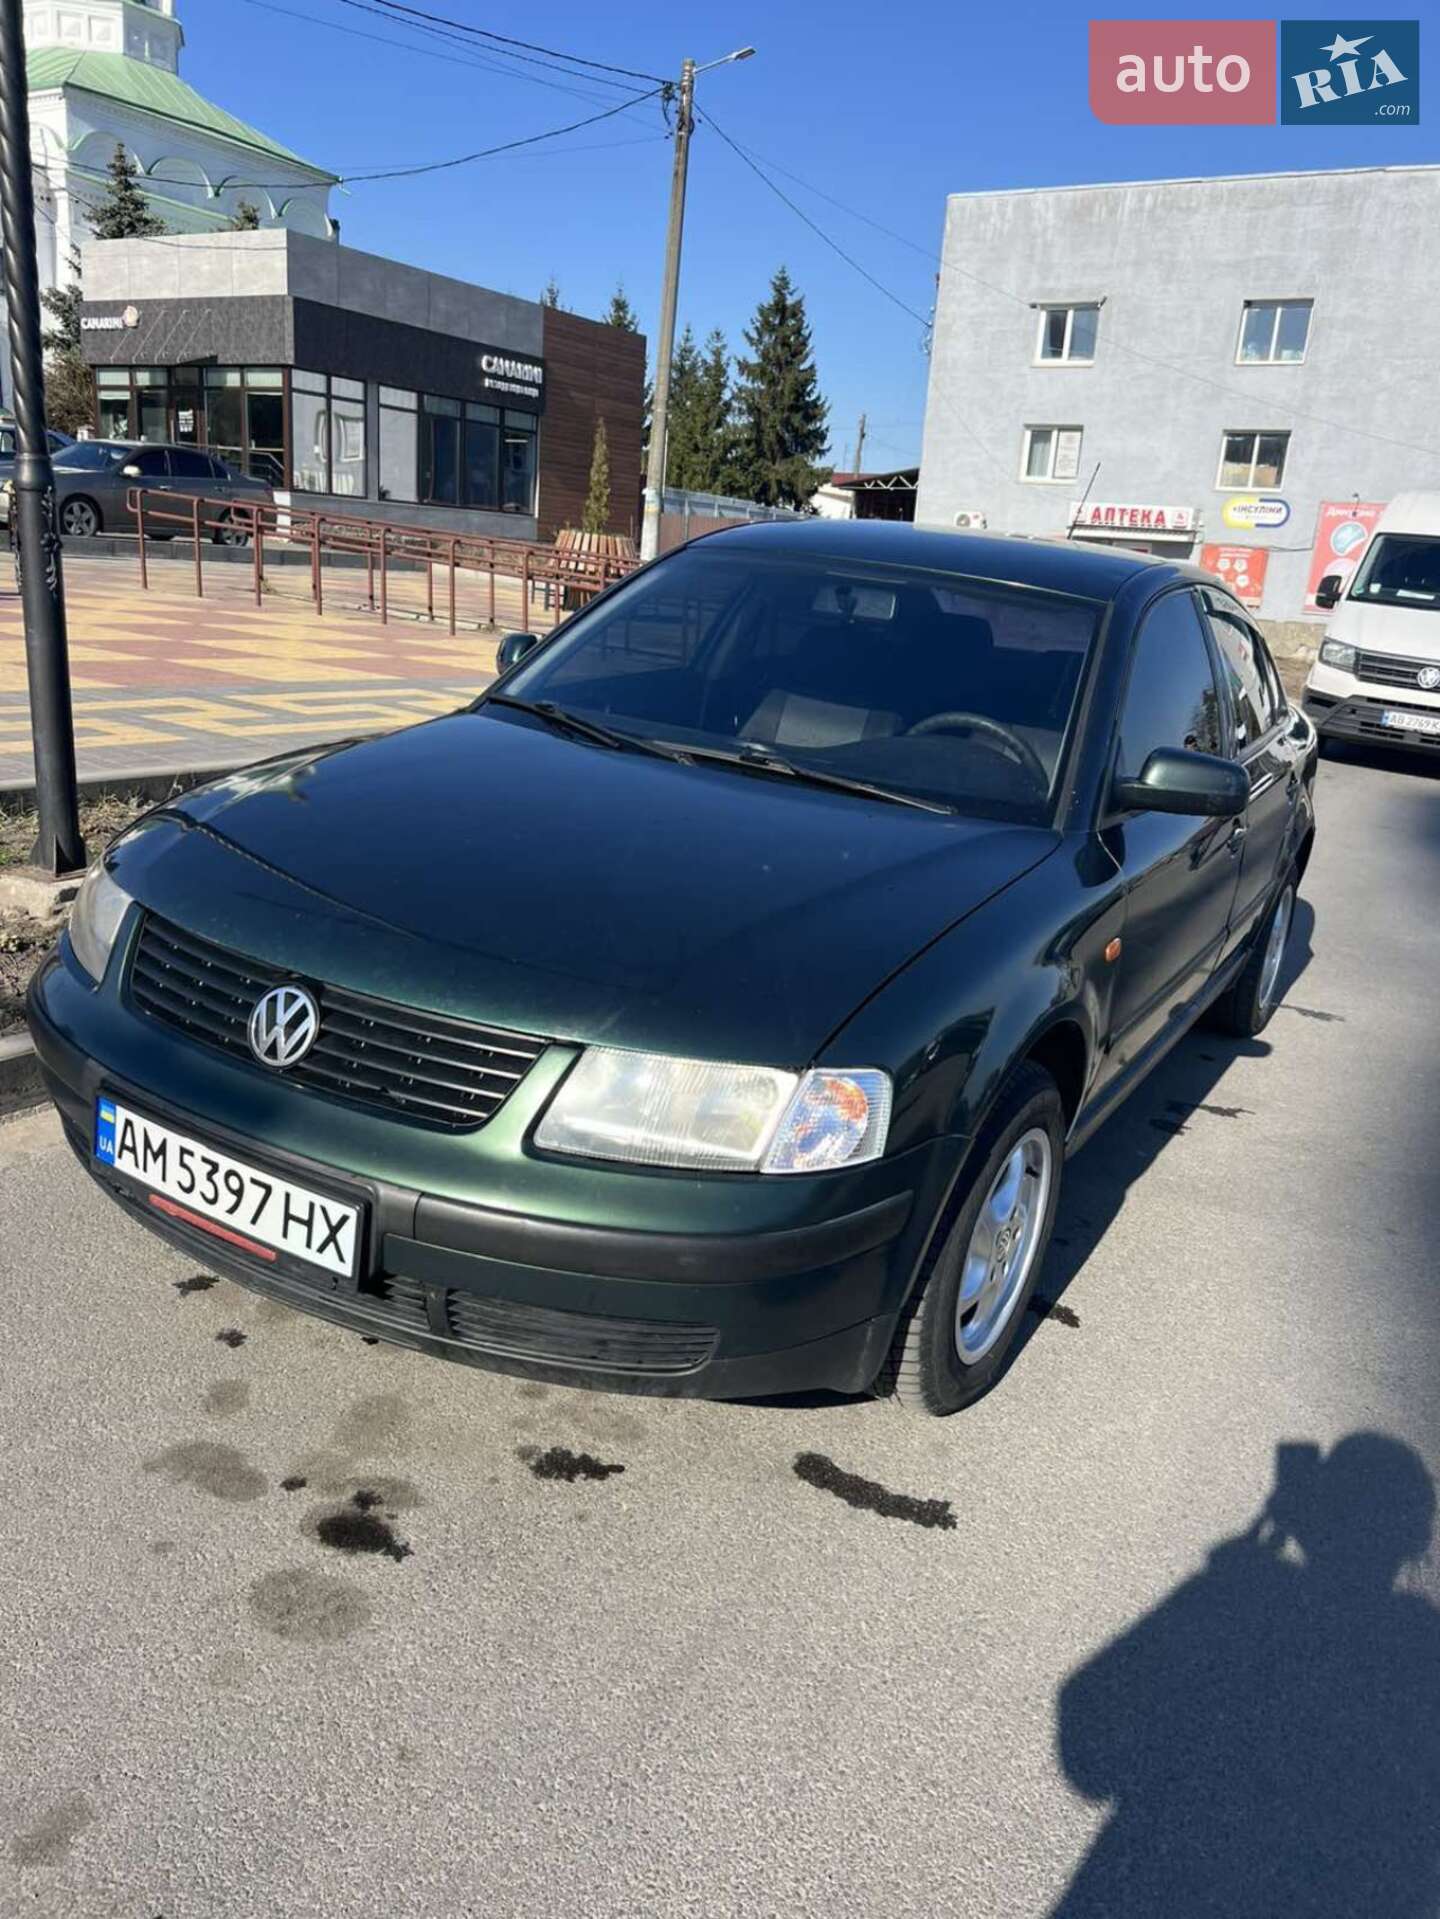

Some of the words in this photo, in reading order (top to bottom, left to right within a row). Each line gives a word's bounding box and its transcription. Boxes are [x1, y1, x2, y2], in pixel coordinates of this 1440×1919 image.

[1091, 507, 1167, 528] АПТЕКА
[98, 1137, 114, 1154] UA
[117, 1118, 167, 1183] AM
[177, 1146, 273, 1226] 5397
[282, 1192, 351, 1264] HX
